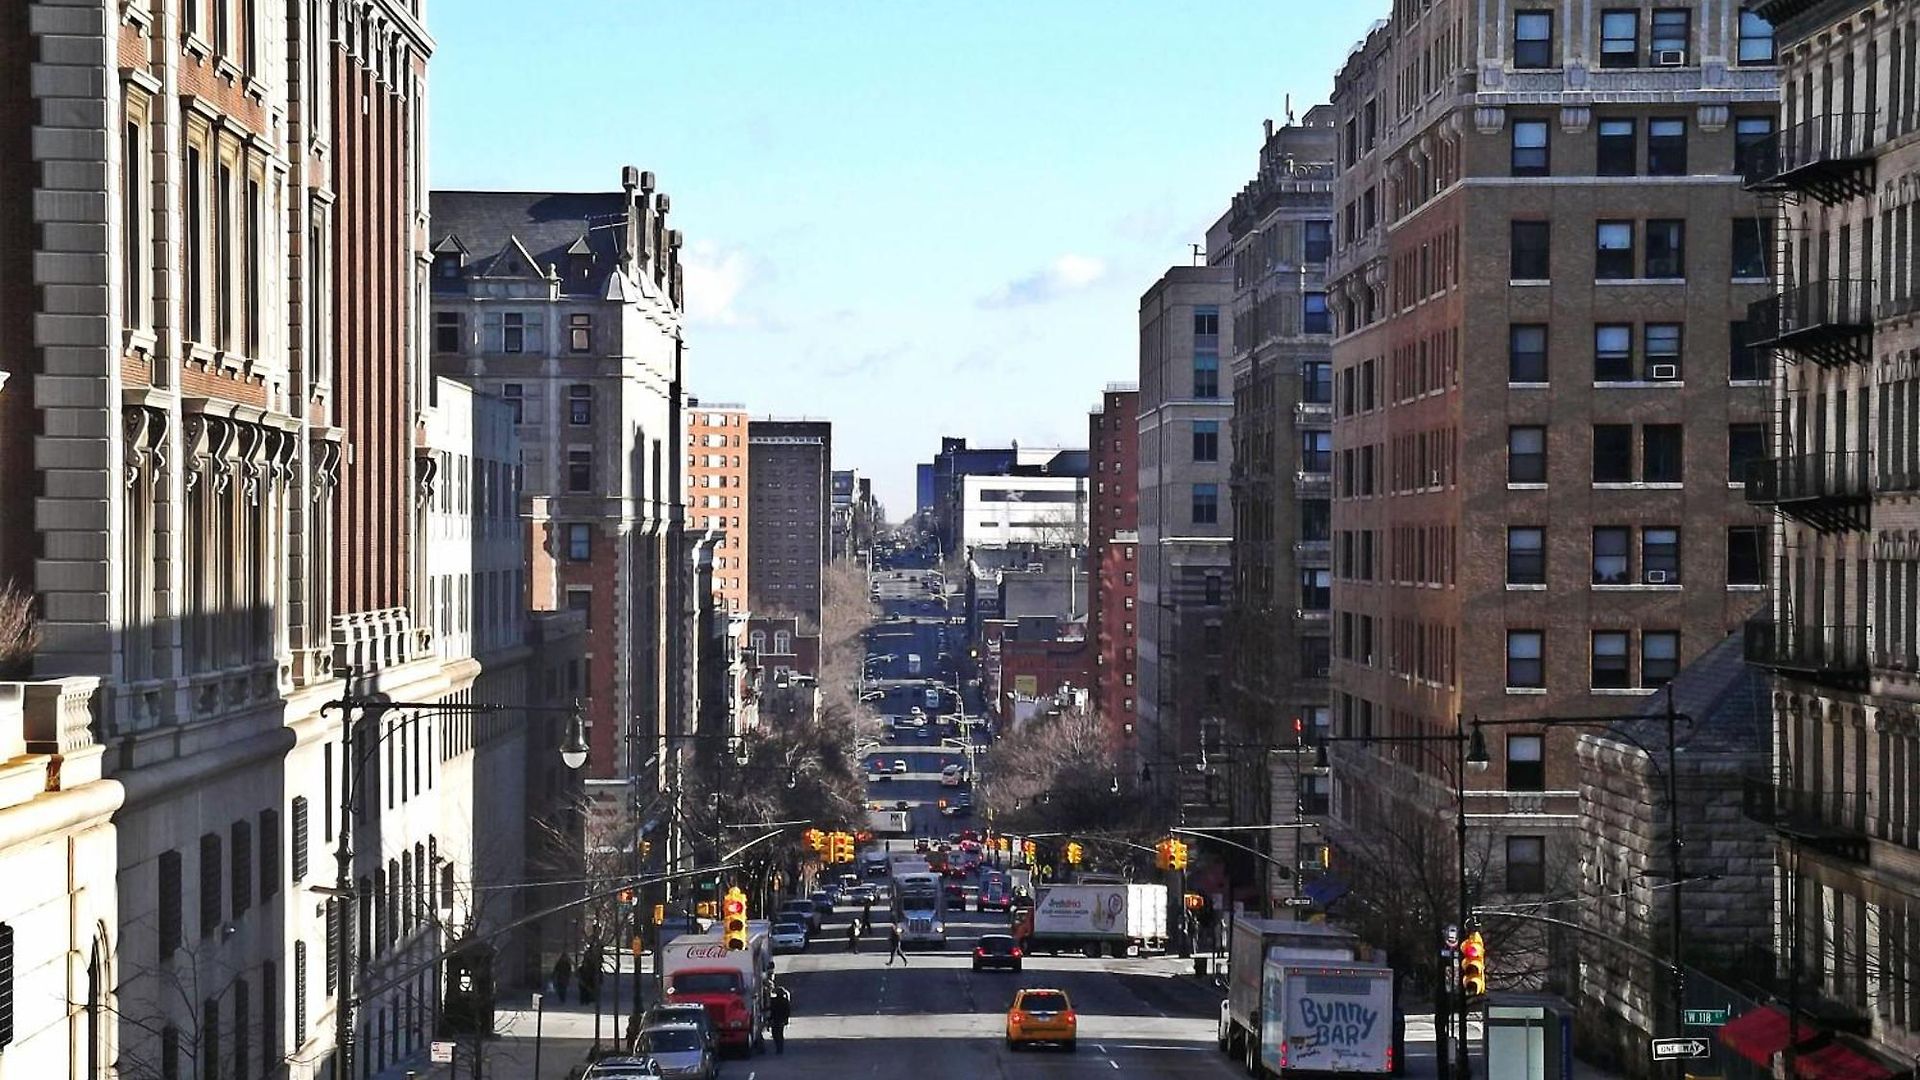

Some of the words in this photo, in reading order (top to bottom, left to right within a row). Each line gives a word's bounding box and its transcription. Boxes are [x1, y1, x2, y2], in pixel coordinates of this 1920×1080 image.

[1300, 997, 1377, 1040] Bunny
[1687, 1012, 1695, 1023] W
[1699, 1012, 1711, 1023] 118
[1315, 1024, 1359, 1046] BAR
